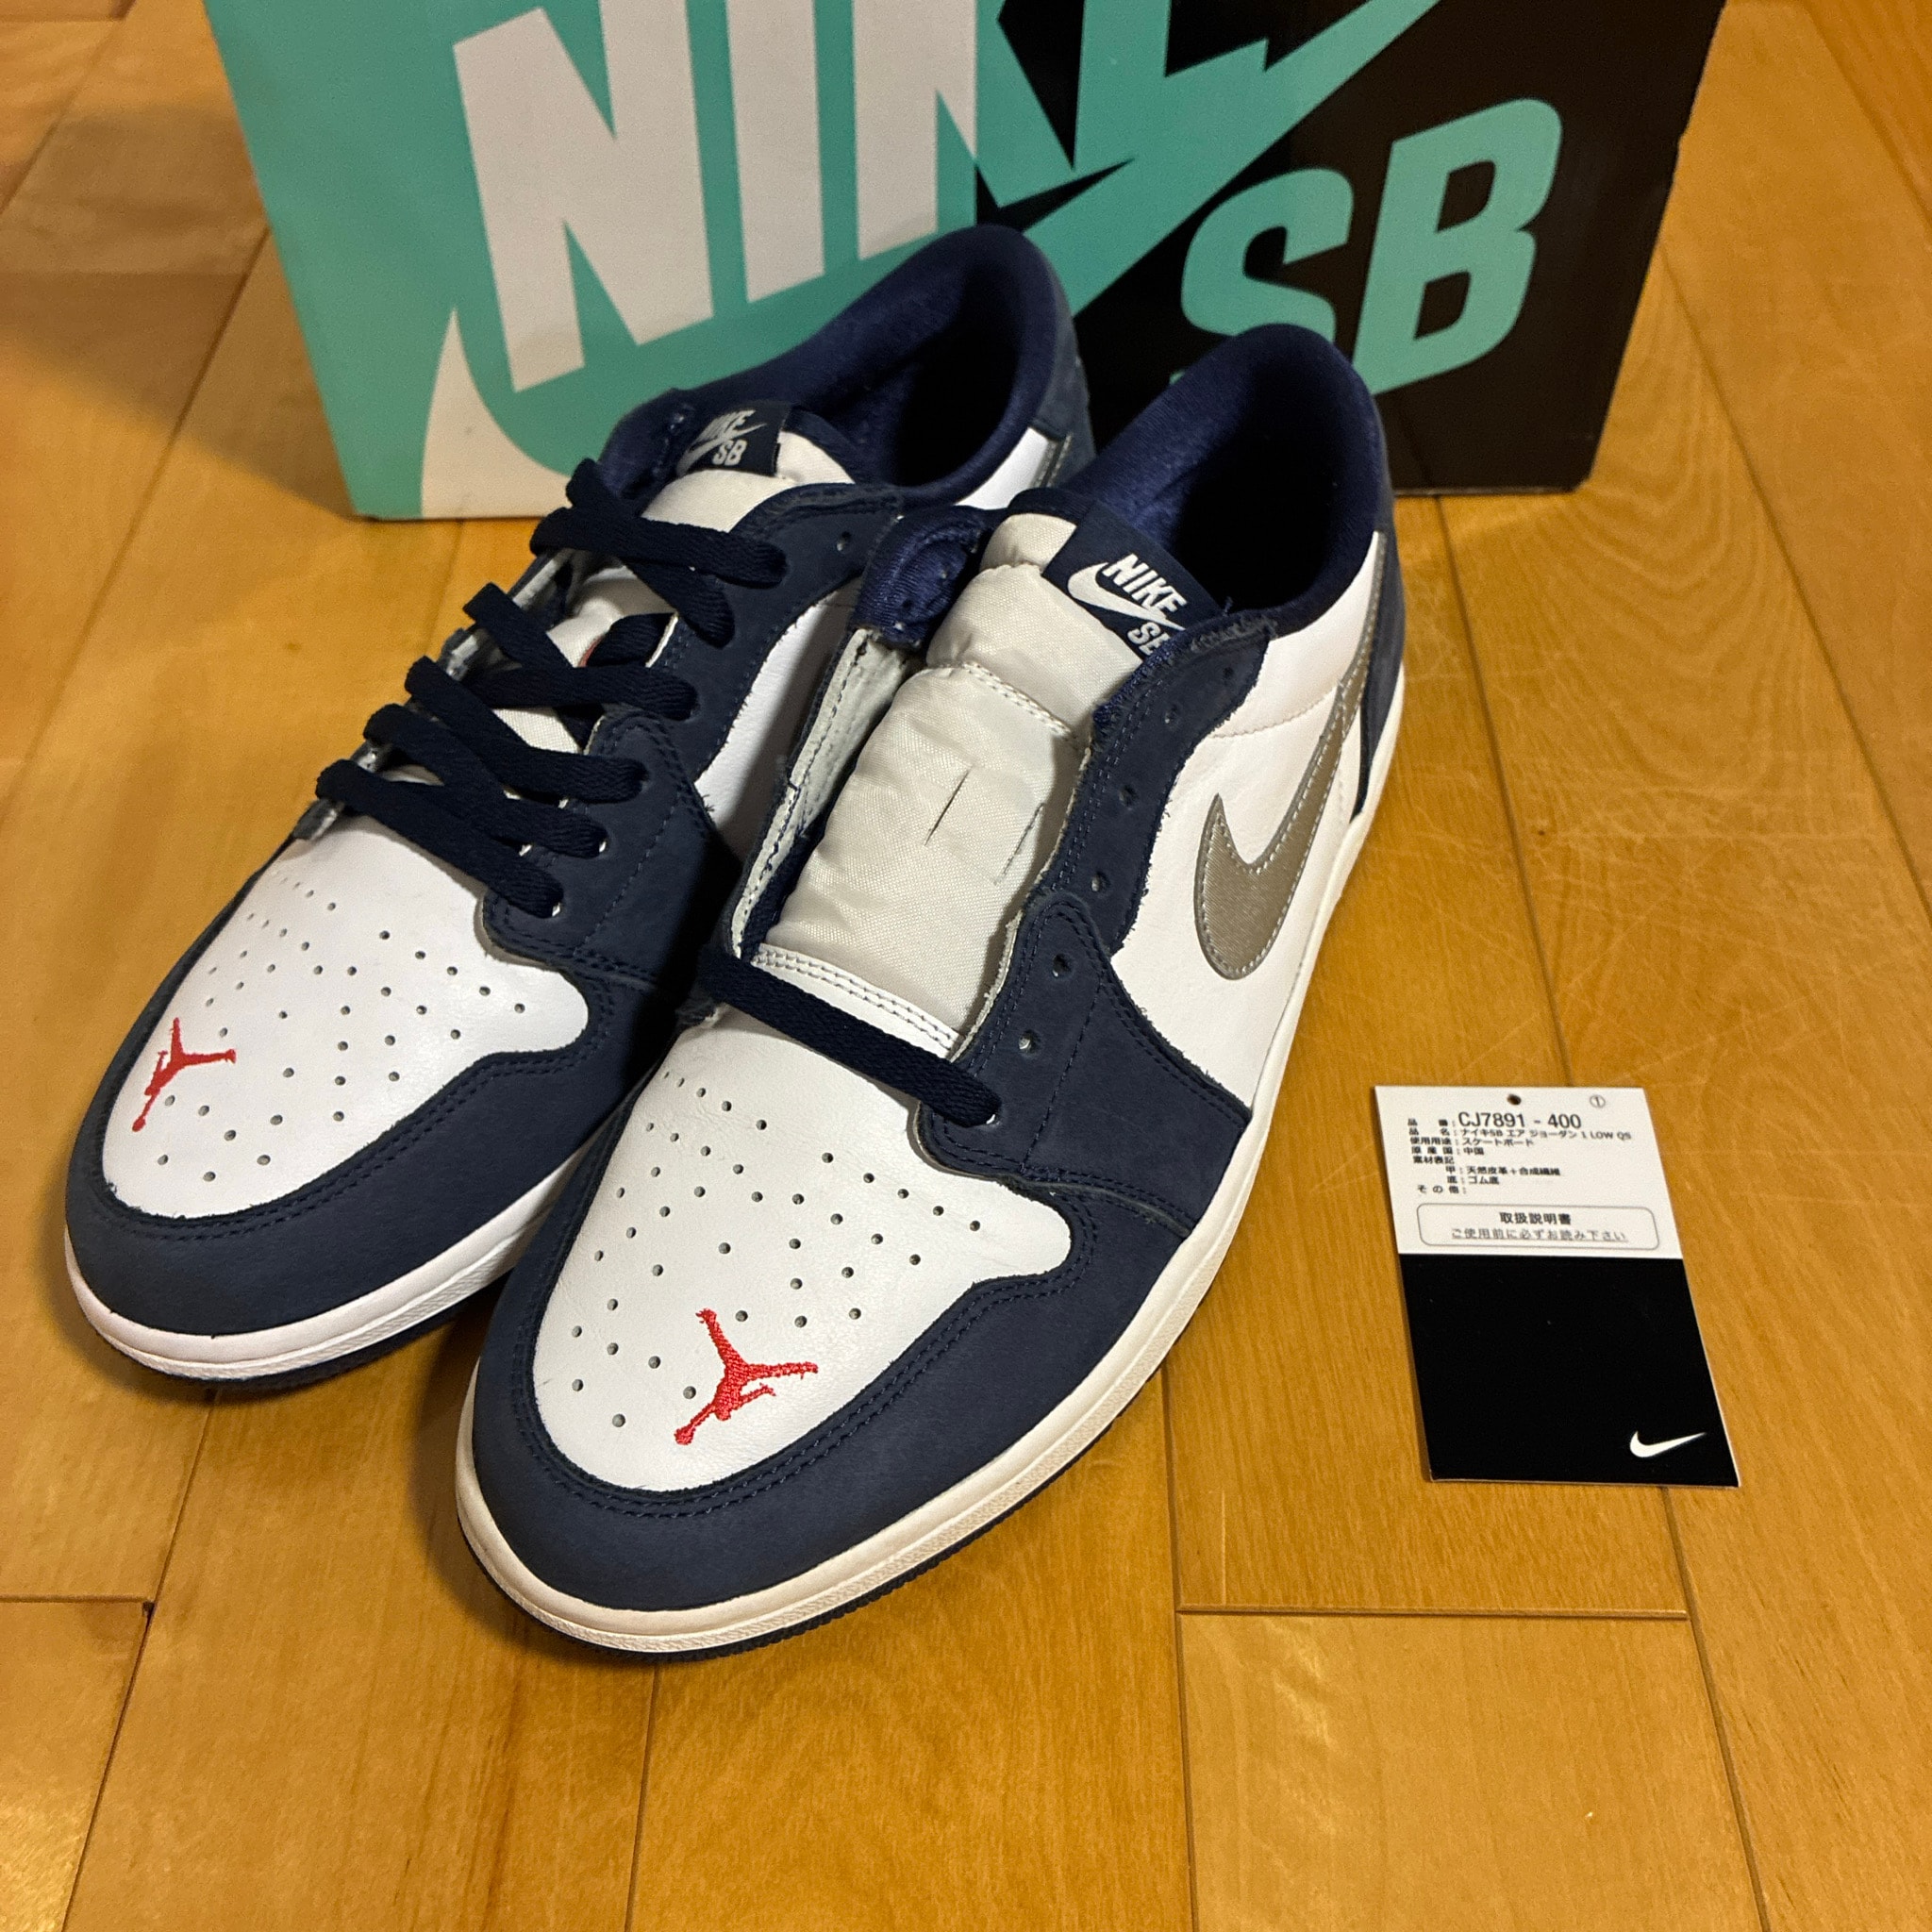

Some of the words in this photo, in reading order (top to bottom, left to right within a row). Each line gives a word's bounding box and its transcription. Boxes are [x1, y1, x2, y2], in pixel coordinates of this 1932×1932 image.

[1171, 98, 1562, 396] SB
[711, 439, 748, 466] SB
[1102, 553, 1188, 621] NIKE
[1457, 1111, 1525, 1127] CJ7891
[1547, 1113, 1582, 1129] 400
[1463, 1146, 1485, 1156] 中国
[1499, 1211, 1572, 1225] 取扱説明書
[1451, 1228, 1626, 1241] ご使用前に必ずお読み下さい
